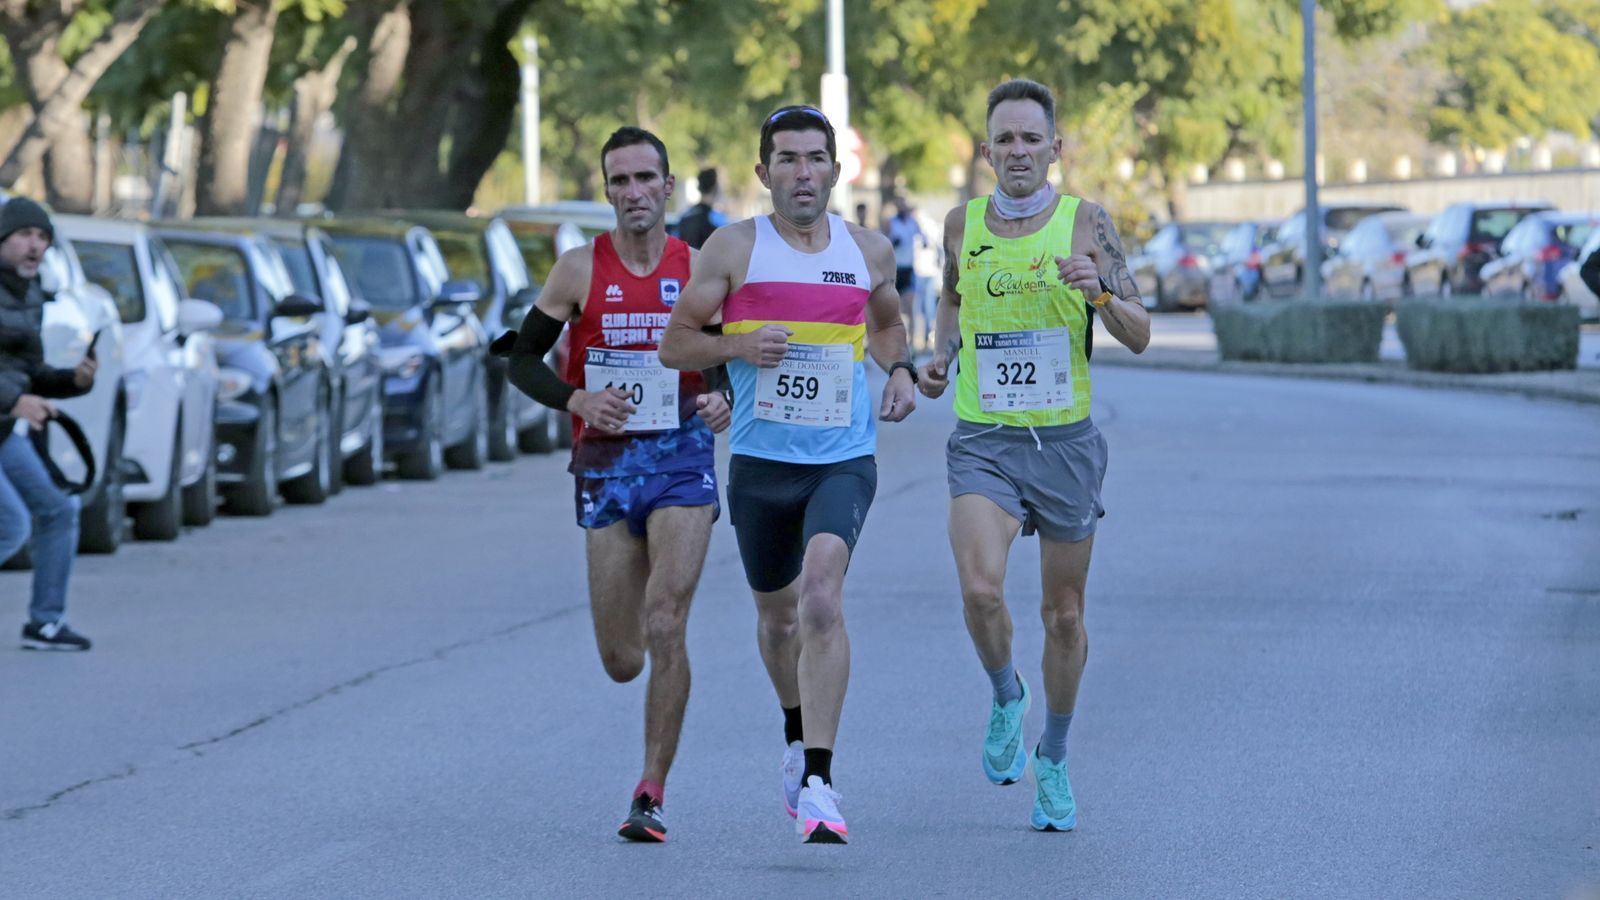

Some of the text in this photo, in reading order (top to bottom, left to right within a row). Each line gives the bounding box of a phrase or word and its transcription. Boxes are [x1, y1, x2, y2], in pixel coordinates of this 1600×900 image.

[822, 271, 857, 285] 226ERS
[602, 313, 627, 328] CLUB
[977, 335, 993, 346] XXV
[587, 351, 606, 363] XXV
[1004, 348, 1040, 356] MANUEL
[780, 360, 840, 371] OSE DOMINGO
[600, 368, 663, 377] JOSE ANTONIO
[996, 362, 1036, 386] 322
[776, 374, 819, 400] 559
